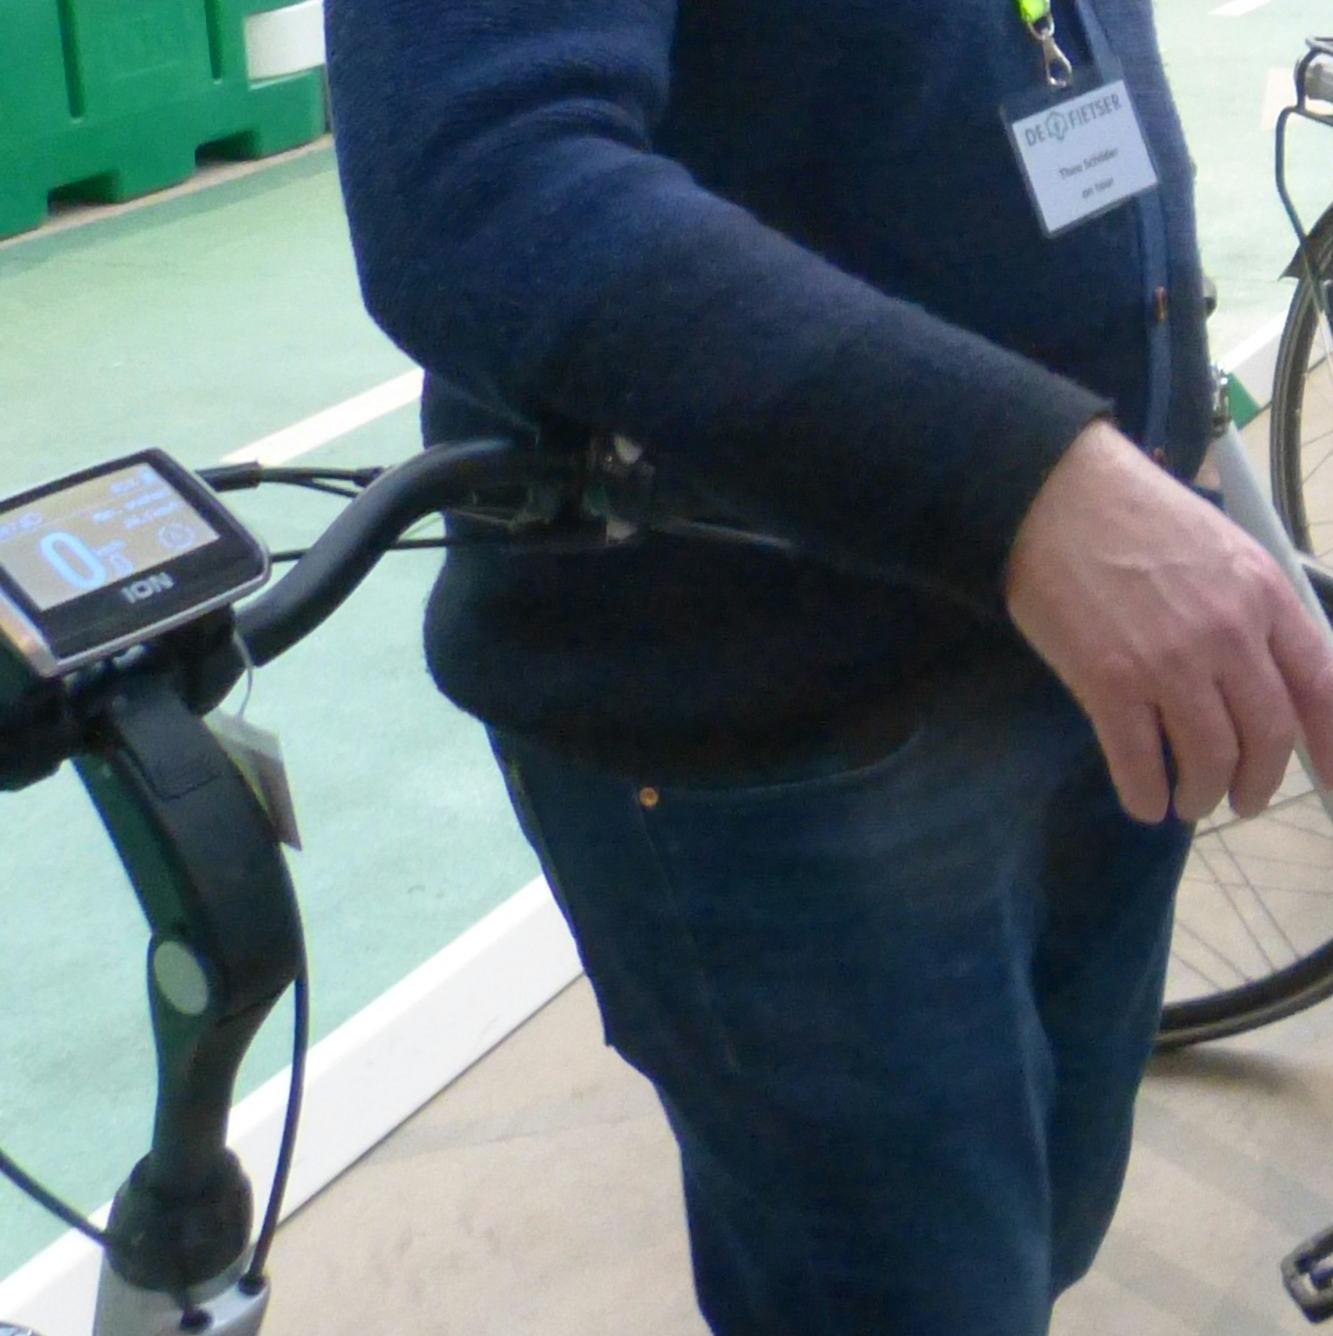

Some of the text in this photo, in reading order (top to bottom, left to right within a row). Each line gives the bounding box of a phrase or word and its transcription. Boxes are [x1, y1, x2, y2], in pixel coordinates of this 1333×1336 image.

[1024, 94, 1122, 147] DE FIETSER
[39, 530, 106, 590] 0
[120, 571, 176, 605] ION
